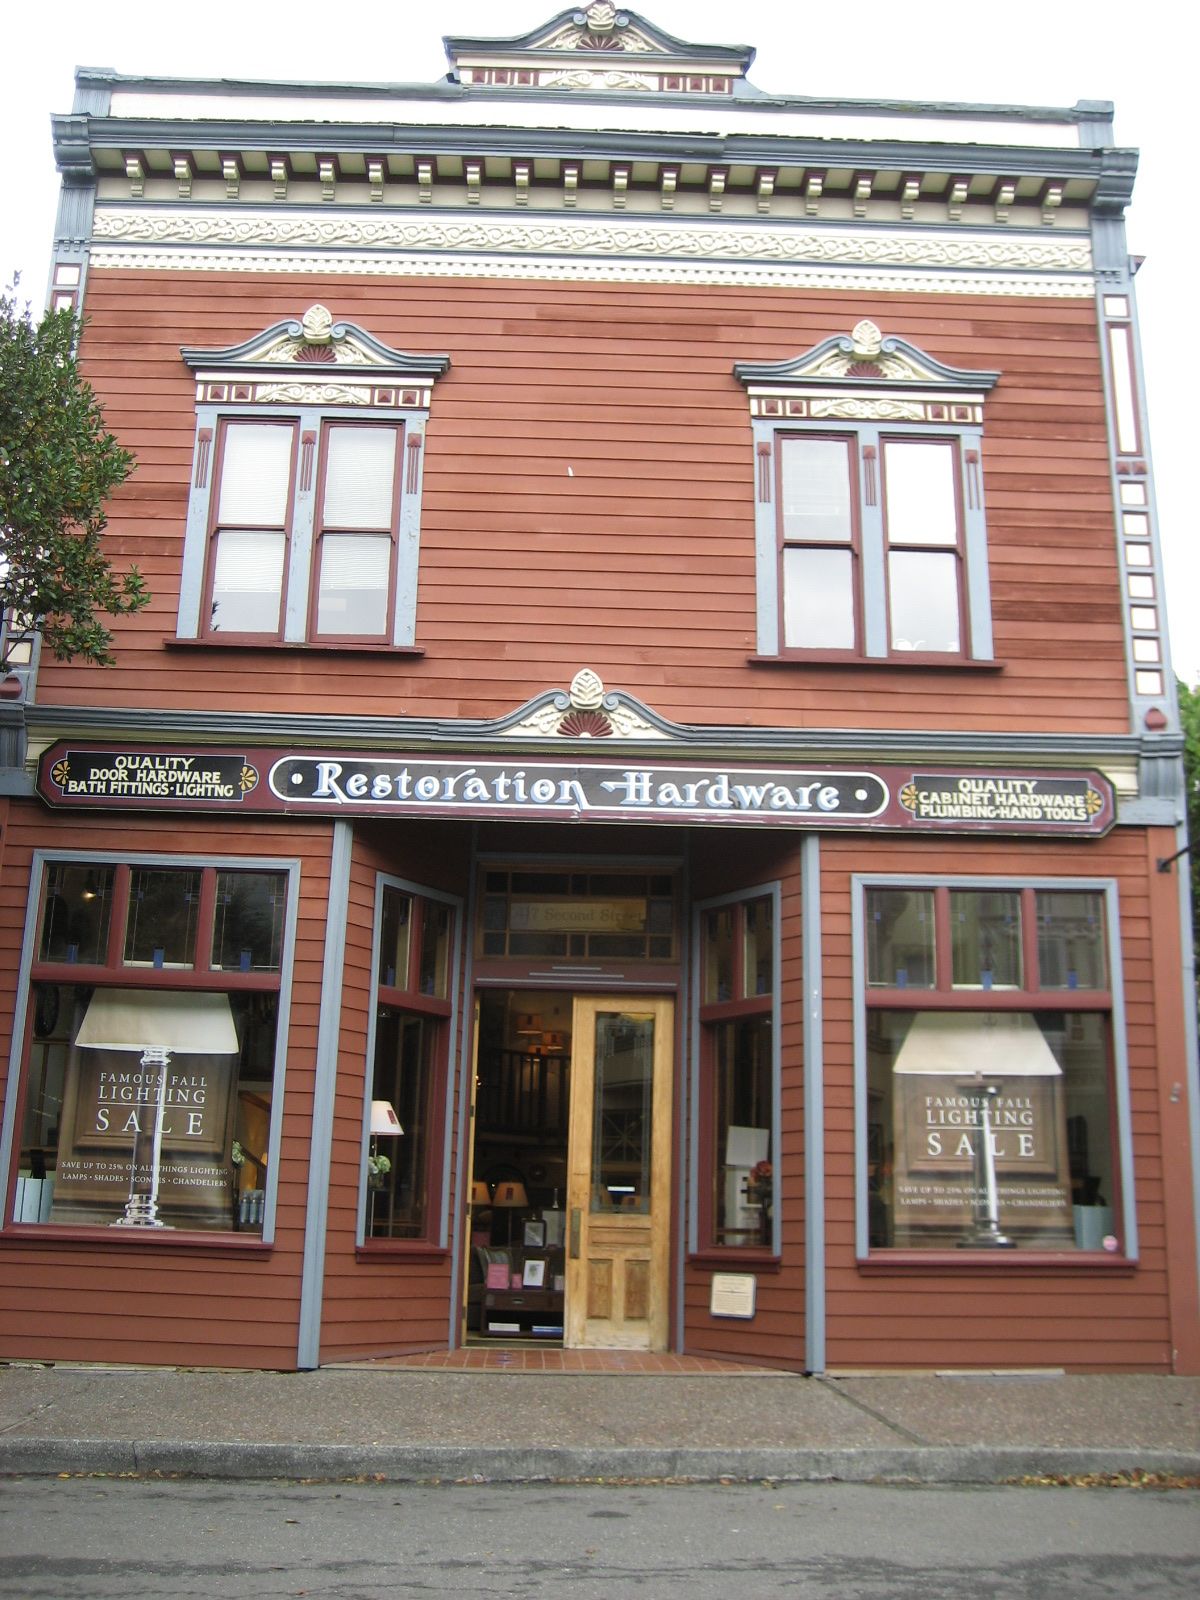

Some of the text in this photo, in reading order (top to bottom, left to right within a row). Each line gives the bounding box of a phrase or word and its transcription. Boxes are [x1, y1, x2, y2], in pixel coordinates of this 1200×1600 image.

[115, 756, 195, 770] QUALITY
[90, 768, 220, 784] DOOR HARDWARE
[68, 780, 106, 794] BATH
[312, 762, 840, 812] Restoration Hardware
[958, 779, 1038, 794] QUALITY
[918, 791, 1085, 808] CABINET HARDWARE
[1044, 808, 1087, 820] TOOLS
[100, 1072, 207, 1087] FAMOUS FALL
[99, 1086, 205, 1104] LIGHTING
[926, 1097, 1032, 1109] FAMOUS FALL
[96, 1108, 203, 1135] SALE
[926, 1110, 1033, 1125] LIGHTING
[927, 1132, 1035, 1157] SALE
[62, 1161, 80, 1169] SAVE
[190, 1167, 228, 1176] LIGHTING
[62, 1173, 88, 1181] LAMPS
[94, 1174, 124, 1182] SHADES
[173, 1177, 227, 1187] CHANDELIERS
